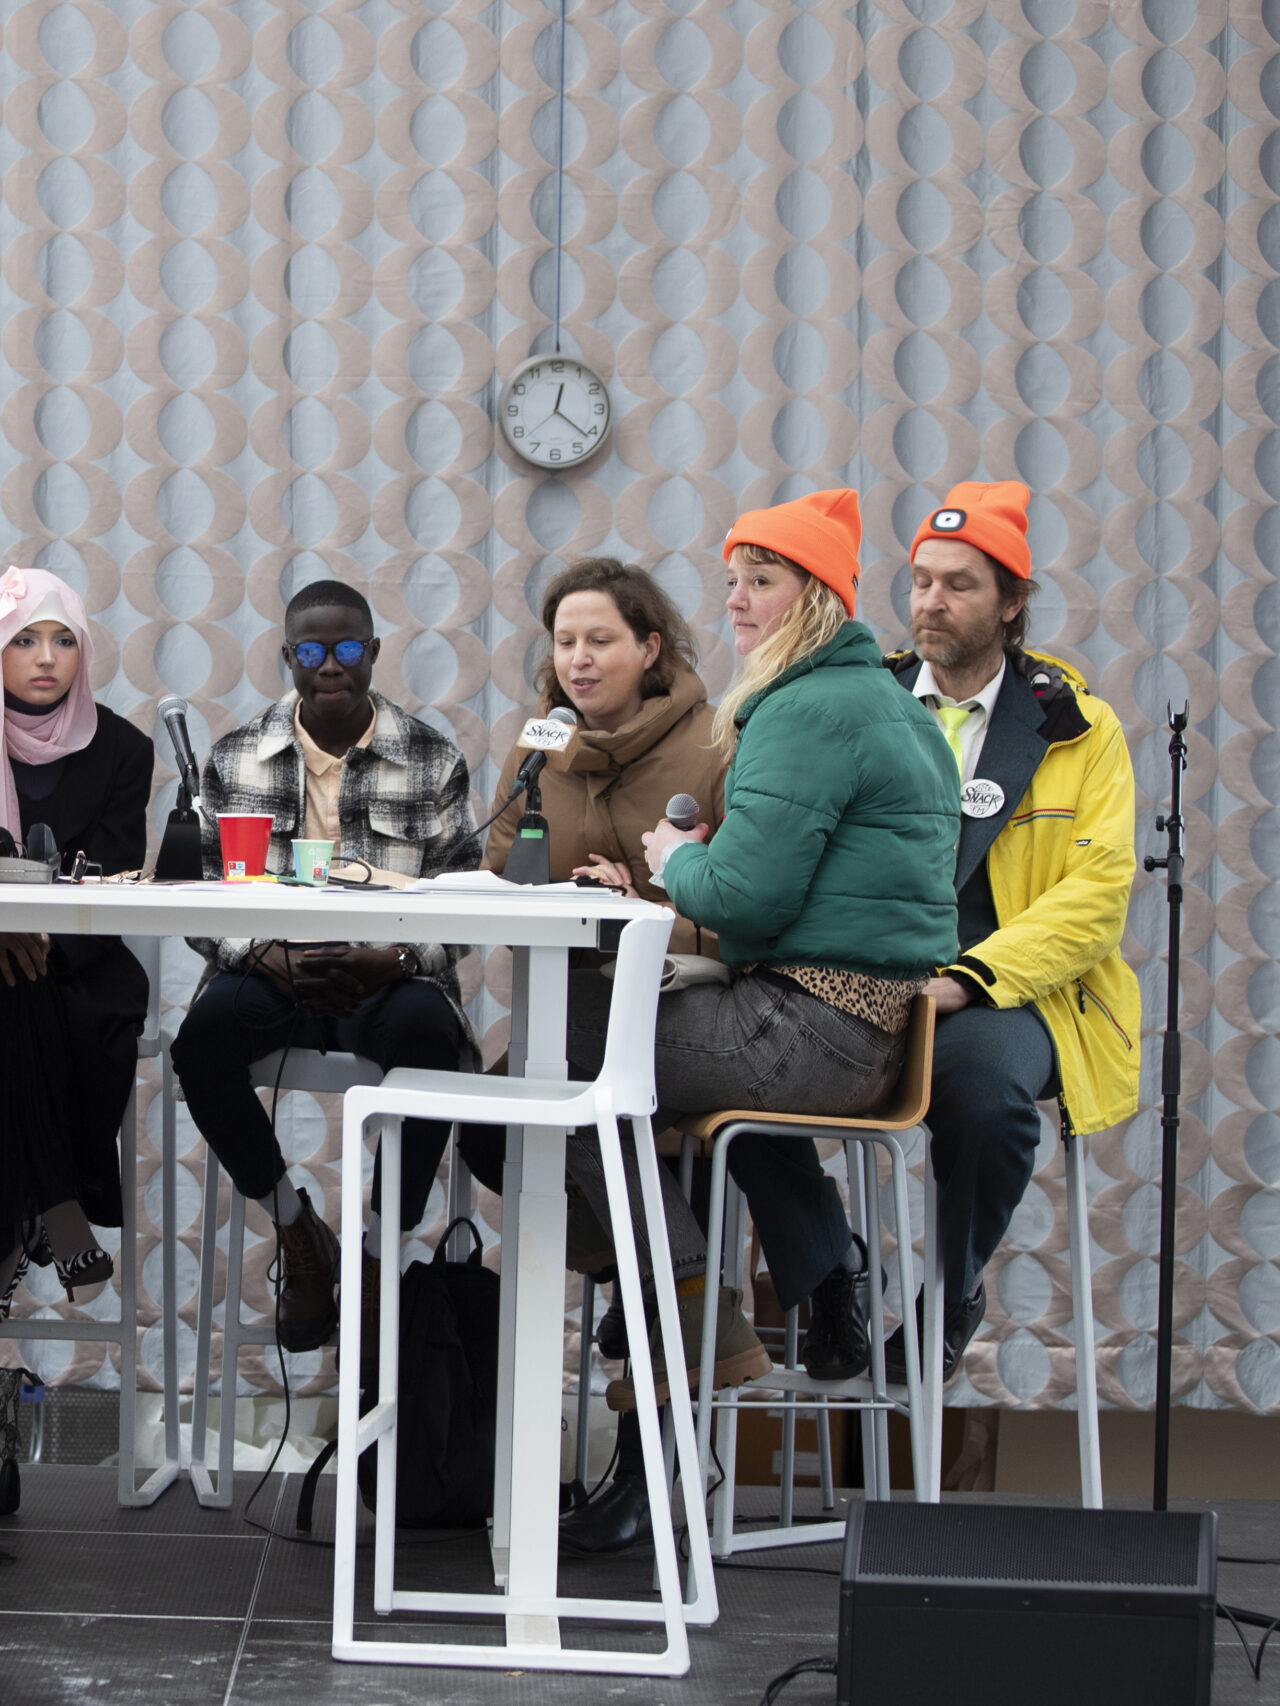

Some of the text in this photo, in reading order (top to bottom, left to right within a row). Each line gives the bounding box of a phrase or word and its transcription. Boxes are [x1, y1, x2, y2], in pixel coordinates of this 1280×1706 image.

[529, 367, 540, 379] 11
[549, 361, 566, 374] 12
[576, 367, 582, 379] 1
[512, 384, 526, 395] 10
[588, 383, 600, 395] 2
[507, 405, 519, 417] 9
[593, 403, 605, 415] 3
[513, 426, 525, 438] 8
[587, 424, 598, 436] 4
[529, 442, 541, 454] 7
[549, 448, 562, 460] 6
[572, 442, 584, 454] 5
[526, 724, 569, 742] SNACK
[960, 786, 1000, 809] SNACK
